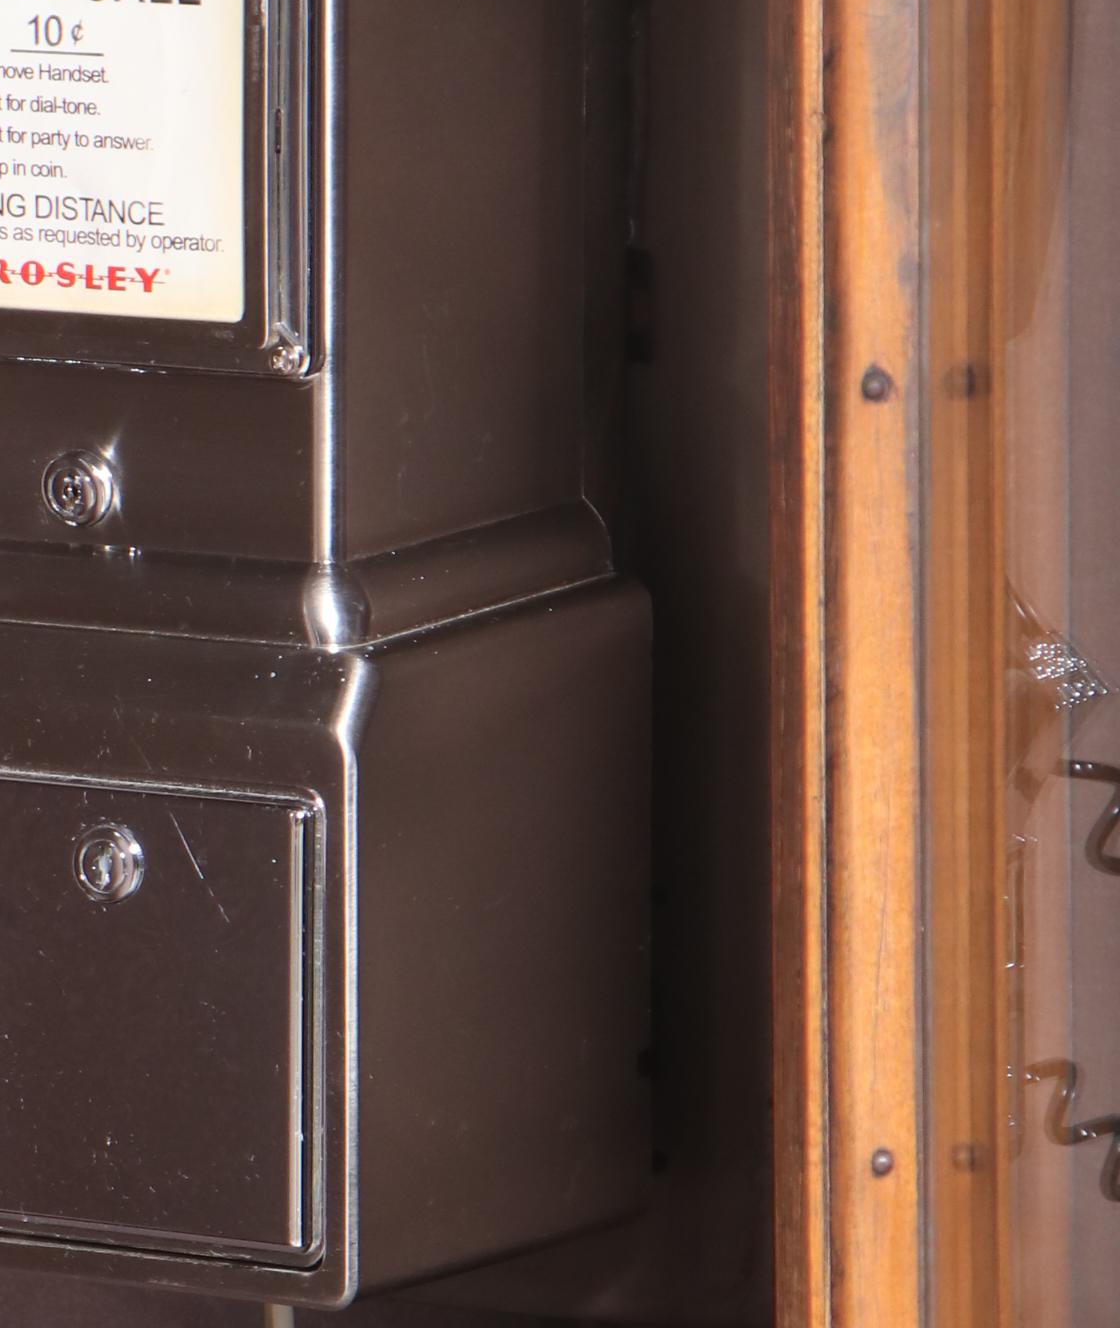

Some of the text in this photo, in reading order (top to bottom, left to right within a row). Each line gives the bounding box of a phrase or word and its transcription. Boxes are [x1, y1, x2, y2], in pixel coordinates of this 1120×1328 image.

[39, 64, 109, 83] Handset.
[6, 94, 25, 111] for
[30, 96, 100, 115] dial-tone.
[6, 126, 27, 143] for
[31, 130, 71, 151] party
[74, 131, 89, 147] to
[93, 135, 154, 151] answer.
[13, 159, 26, 176] in
[31, 161, 67, 178] coin.
[35, 195, 164, 226] DISTANCE
[13, 227, 34, 241] as
[39, 228, 120, 247] requested
[126, 229, 146, 253] by
[151, 235, 224, 253] operator.
